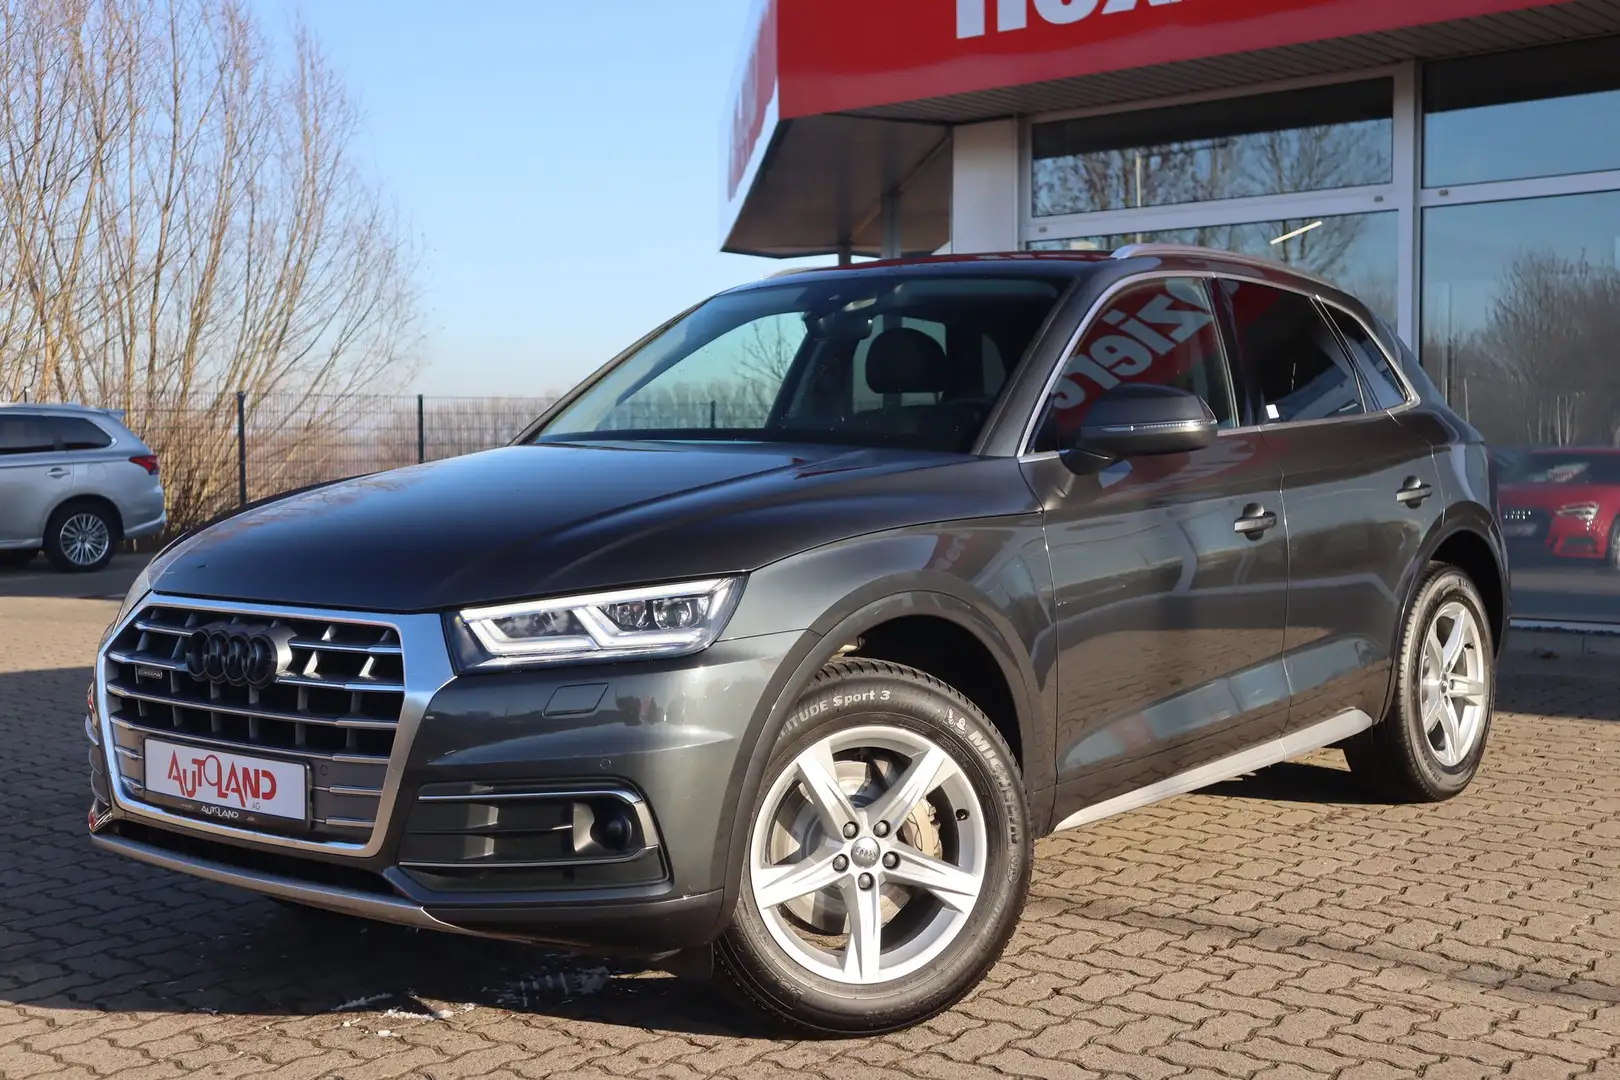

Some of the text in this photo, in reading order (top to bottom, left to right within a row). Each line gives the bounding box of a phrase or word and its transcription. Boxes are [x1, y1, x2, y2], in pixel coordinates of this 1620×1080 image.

[832, 689, 876, 707] Sport
[880, 690, 891, 701] 3
[167, 750, 277, 808] AUTOLAND
[200, 804, 239, 819] AUTOLAND
[251, 801, 261, 811] AG
